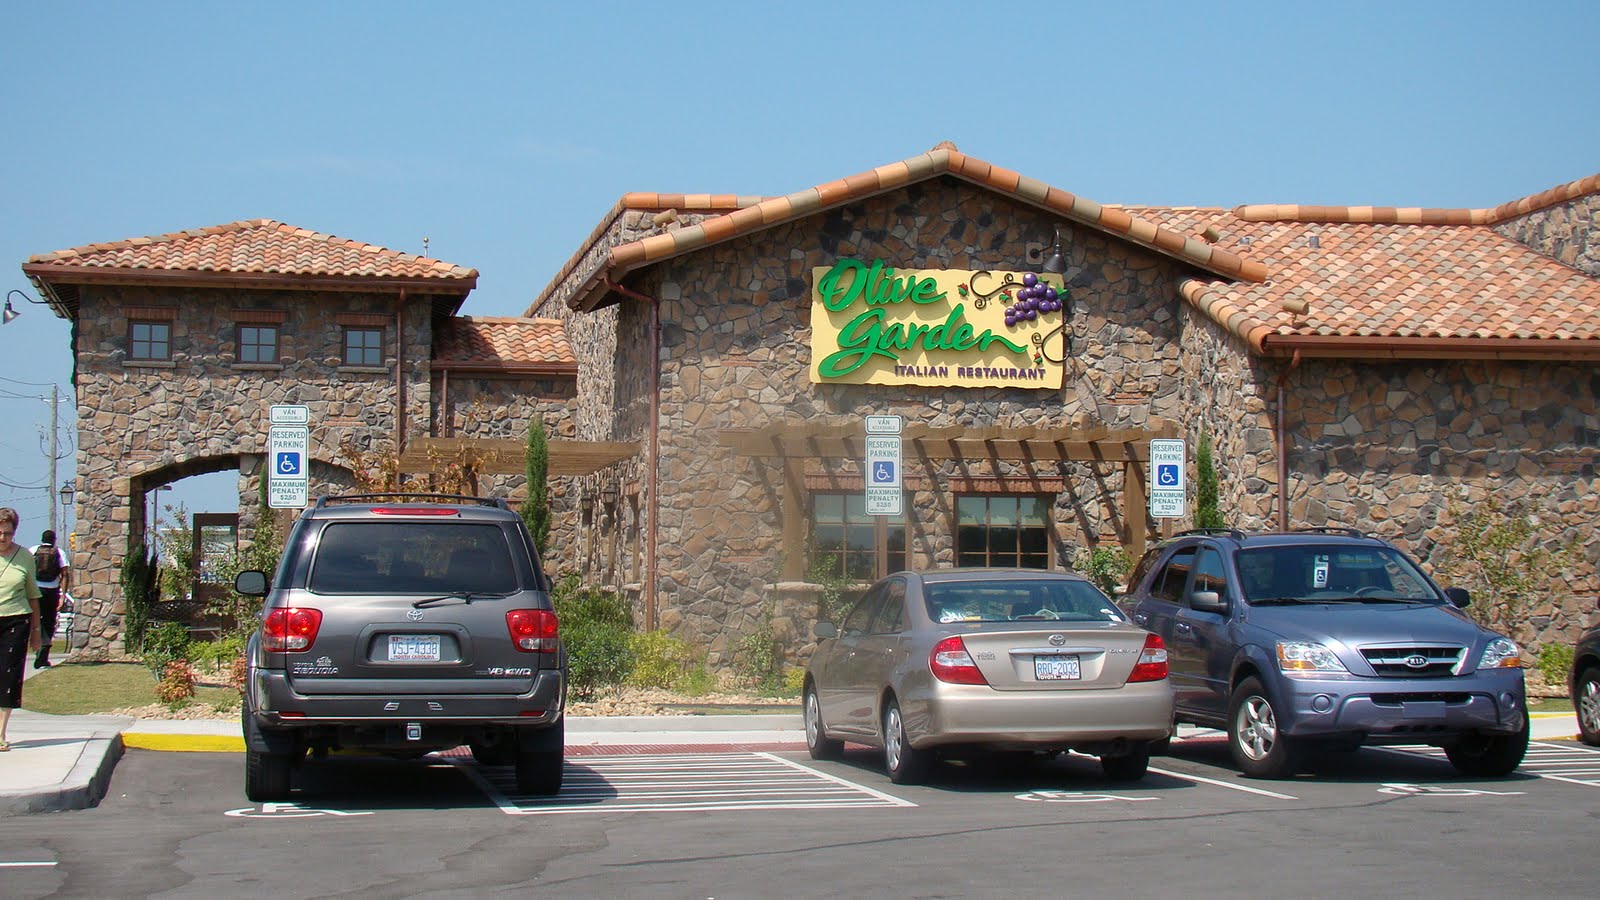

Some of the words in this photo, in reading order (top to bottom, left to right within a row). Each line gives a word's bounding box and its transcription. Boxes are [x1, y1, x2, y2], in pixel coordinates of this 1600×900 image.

[818, 257, 948, 311] Olive
[818, 303, 1028, 378] Garden
[895, 365, 948, 378] ITALIAN
[957, 367, 1046, 380] RESTAURANT
[272, 431, 306, 439] RESERVED
[273, 441, 304, 449] PARKING
[868, 441, 899, 449] RESERVED
[1153, 444, 1183, 452] RESERVED
[869, 450, 898, 458] PARKING
[1154, 453, 1182, 461] PARKING
[293, 667, 339, 675] SEQUOIA
